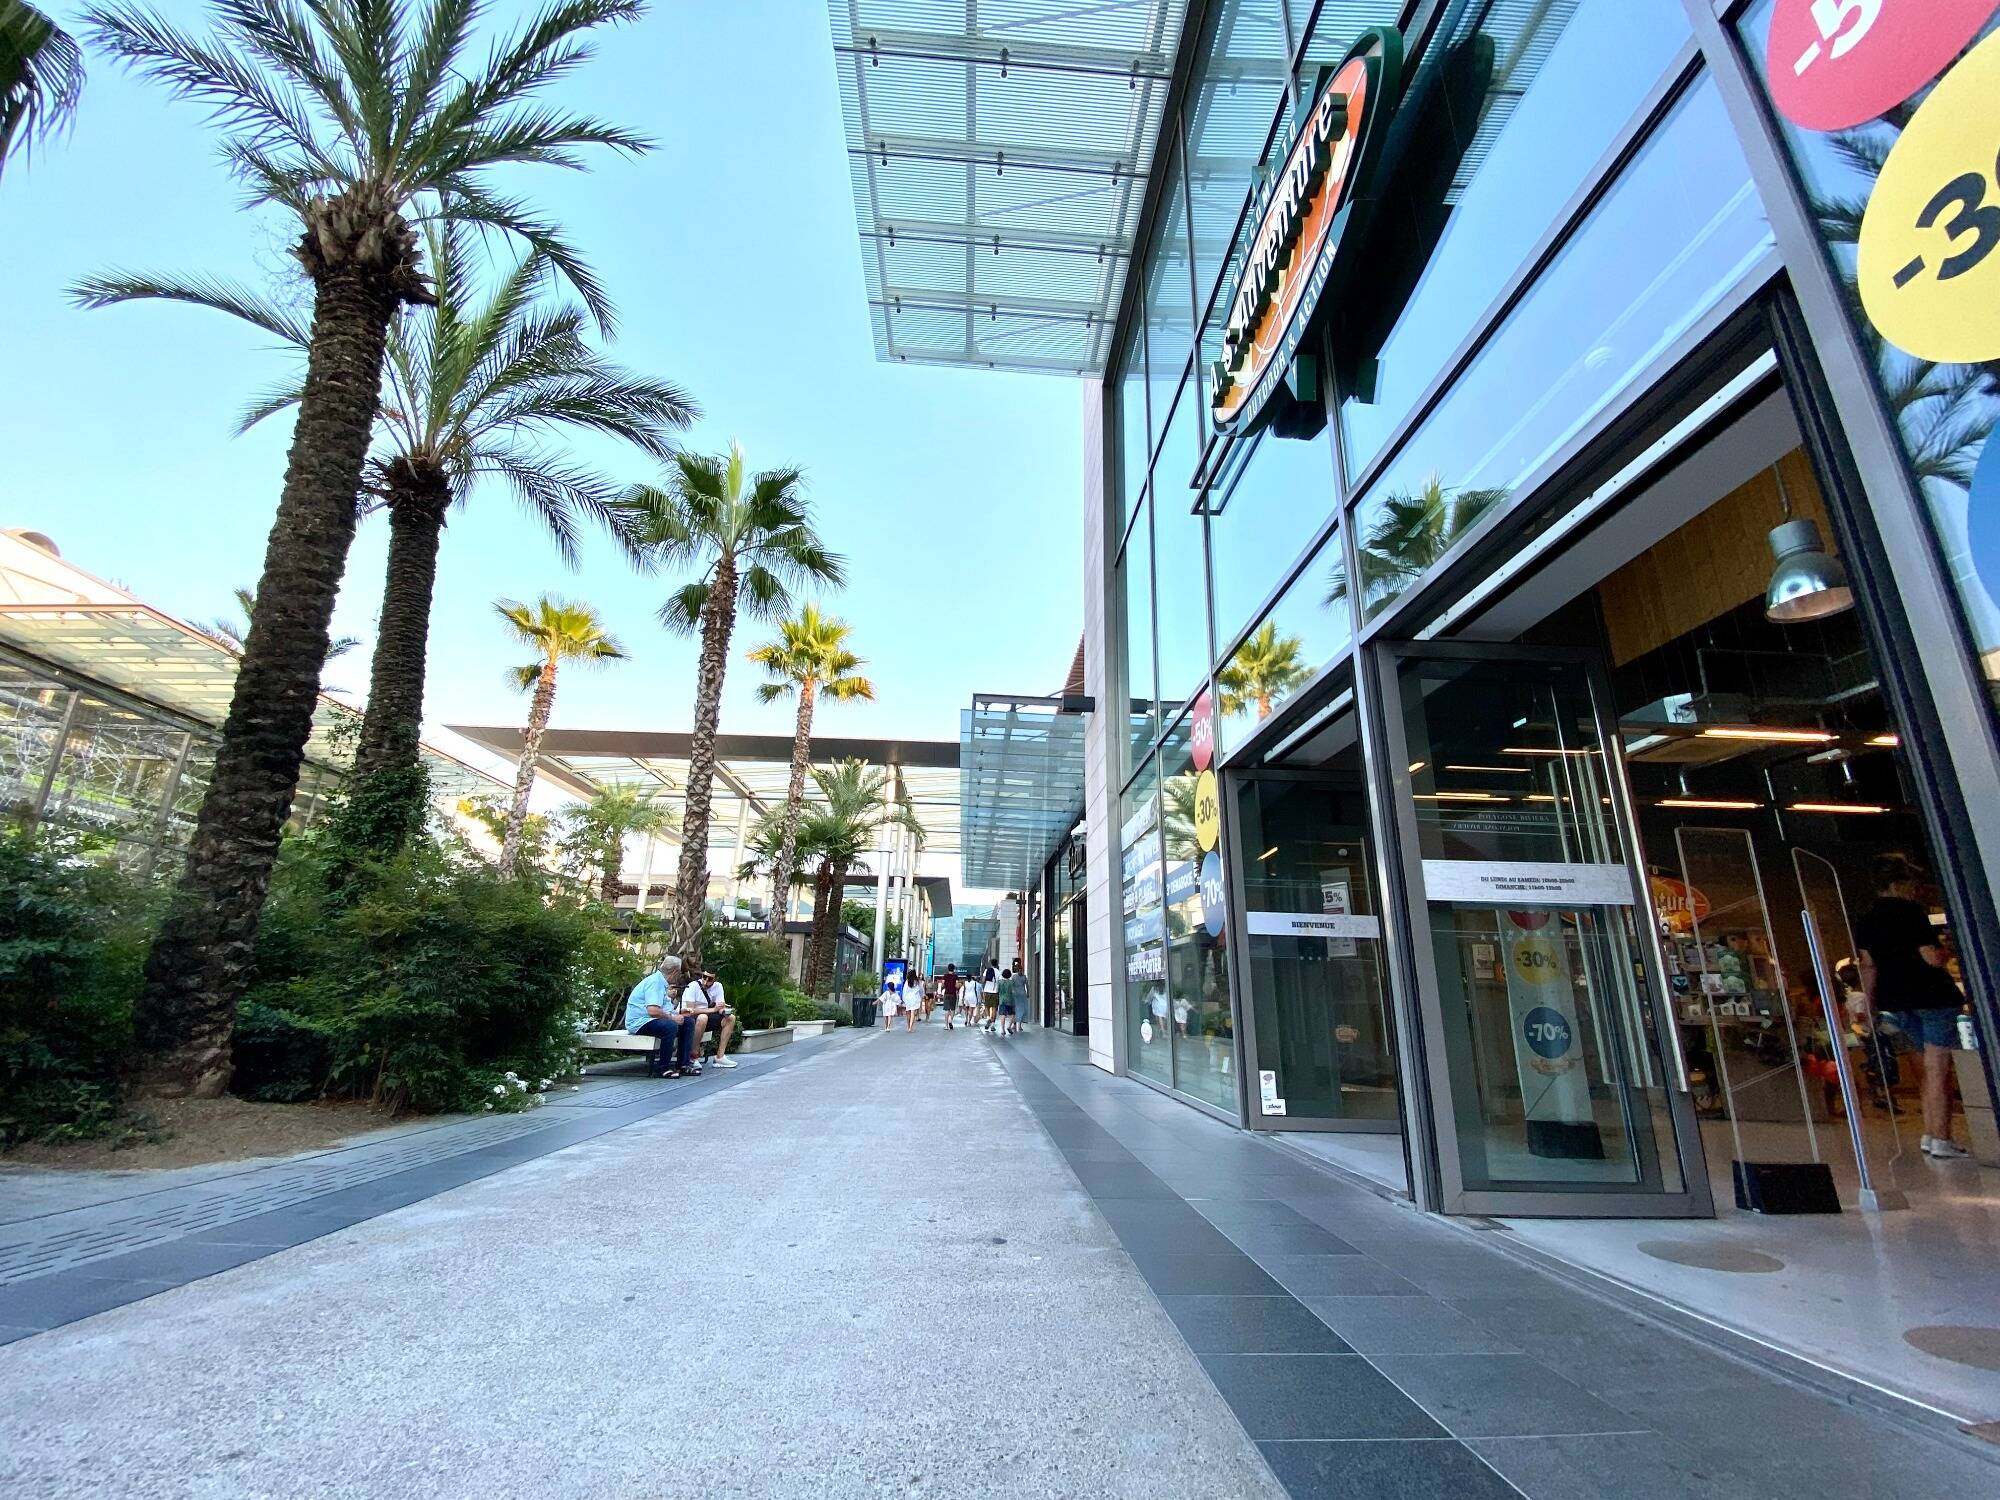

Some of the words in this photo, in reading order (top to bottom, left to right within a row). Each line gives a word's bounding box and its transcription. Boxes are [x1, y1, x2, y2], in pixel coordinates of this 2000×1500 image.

[1232, 168, 1277, 289] WELCOME
[1282, 120, 1297, 158] TO
[1893, 144, 2000, 290] -3
[1246, 352, 1286, 423] OUTDOOR
[1287, 332, 1296, 350] &
[1297, 238, 1338, 332] ACTION
[1193, 718, 1213, 747] -50%
[1197, 795, 1217, 825] -30%
[1202, 878, 1223, 908] -70%
[1291, 921, 1336, 930] BIENVENUE
[1516, 950, 1557, 969] -30%
[1528, 1022, 1569, 1042] -70%
